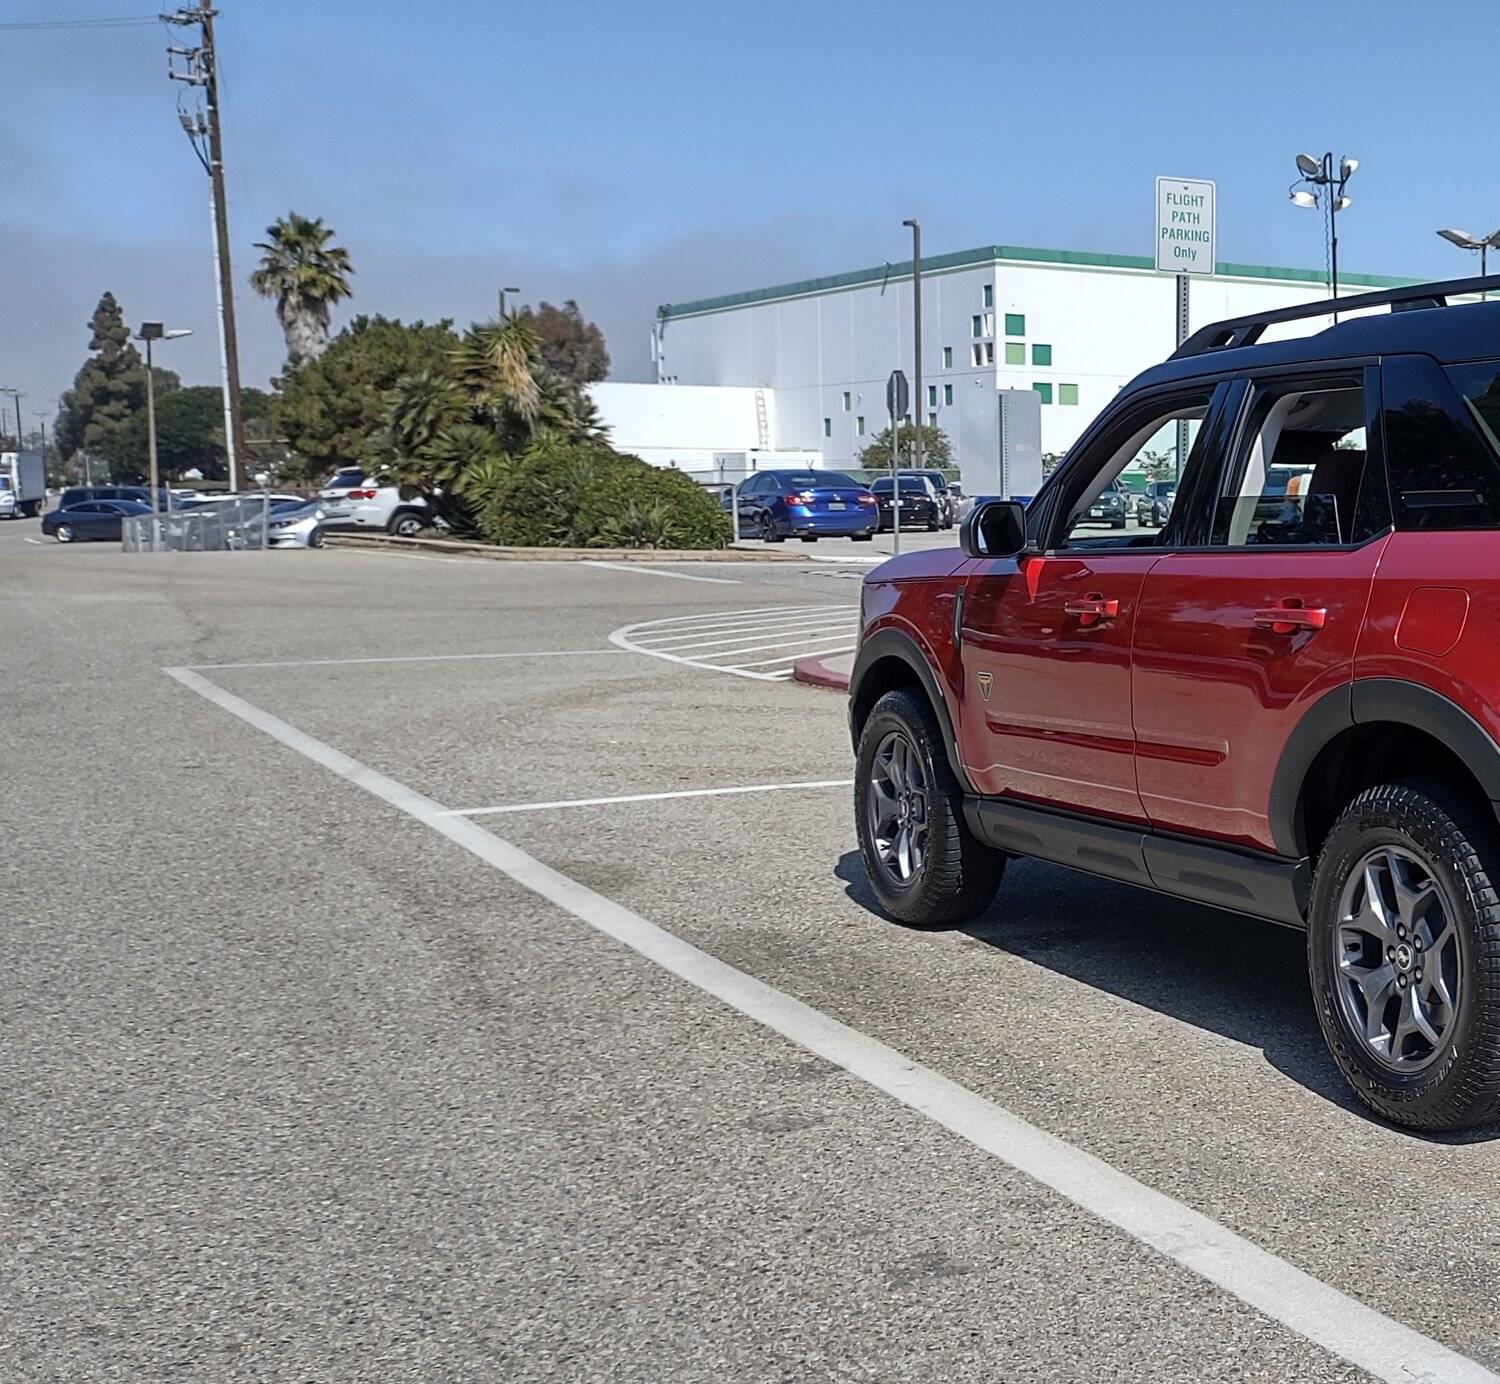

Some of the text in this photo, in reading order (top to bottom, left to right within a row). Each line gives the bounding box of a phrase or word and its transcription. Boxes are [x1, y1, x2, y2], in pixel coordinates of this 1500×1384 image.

[1166, 193, 1205, 207] FLIGHT
[1172, 211, 1200, 224] PATH
[1161, 227, 1210, 242] PARKING
[1174, 245, 1197, 261] Only
